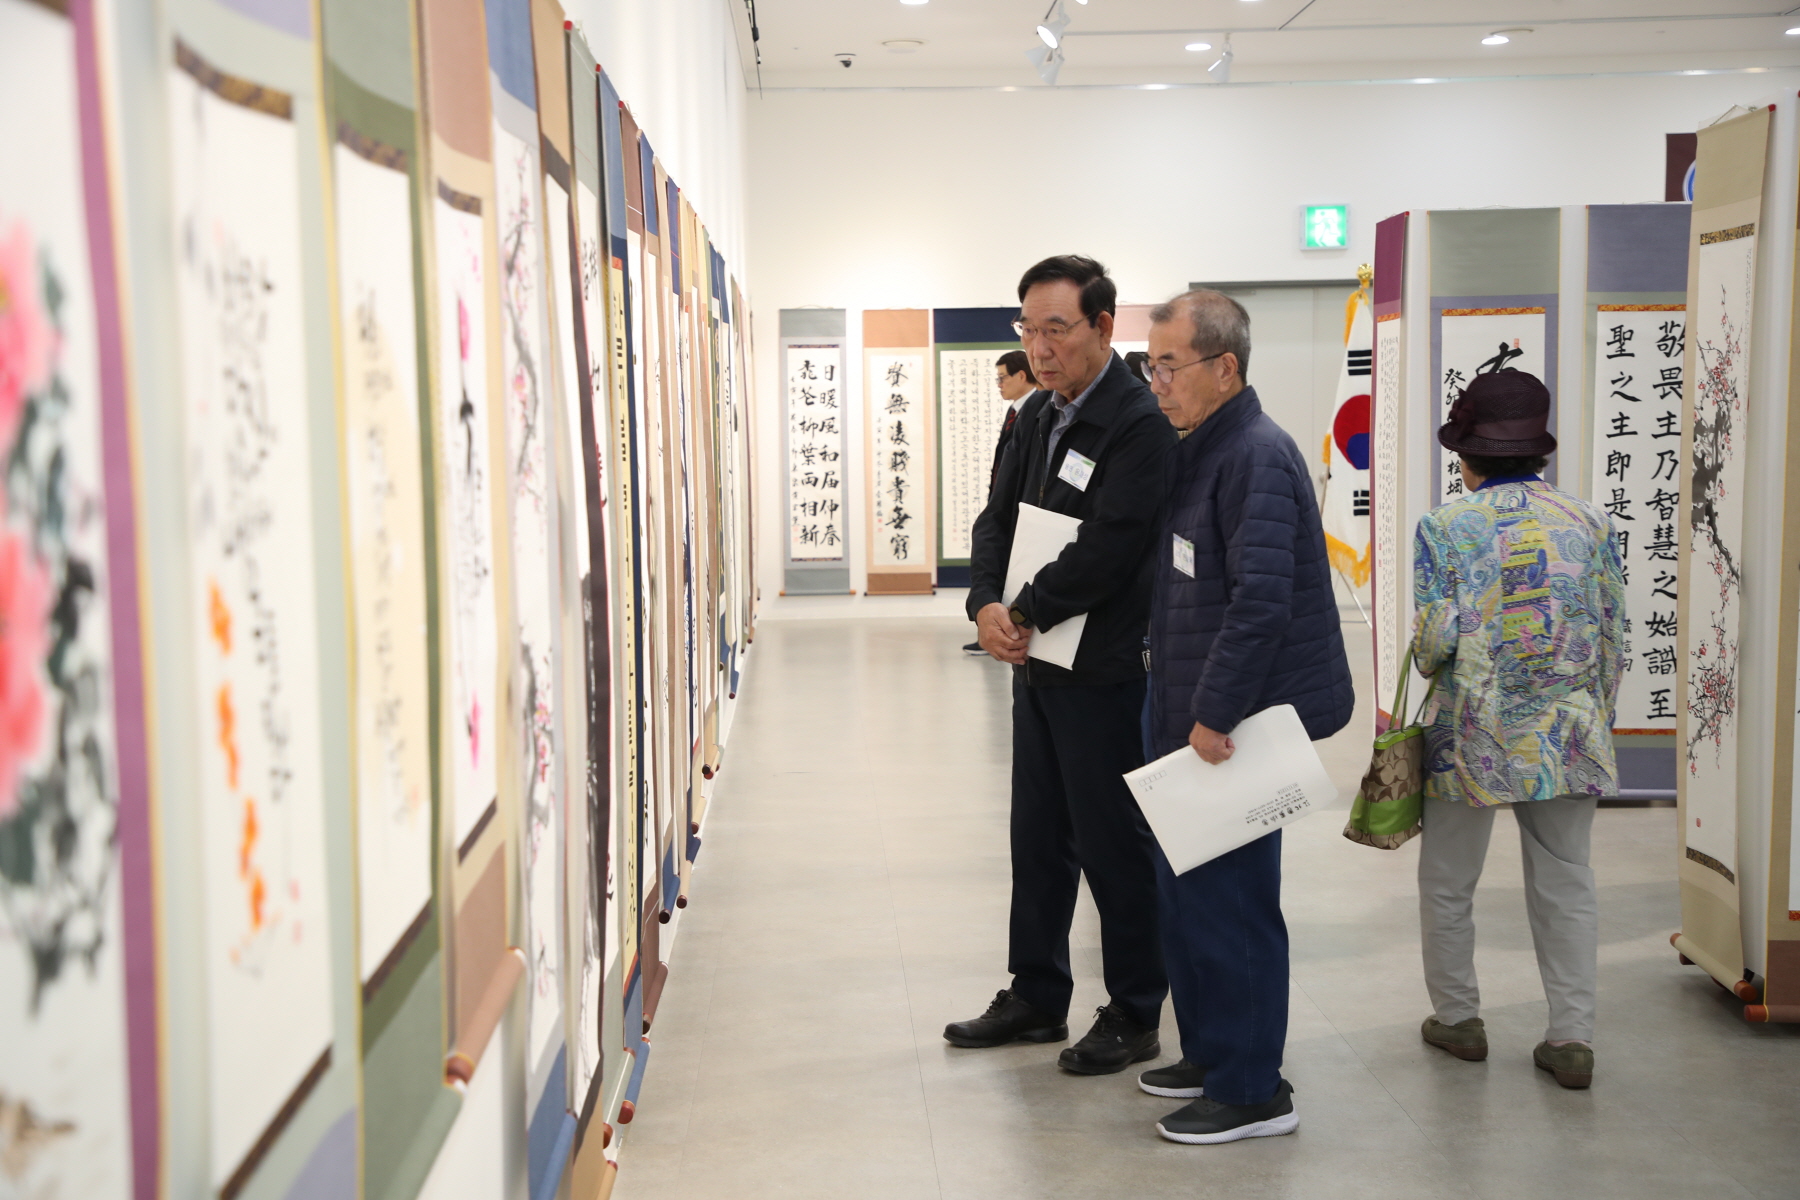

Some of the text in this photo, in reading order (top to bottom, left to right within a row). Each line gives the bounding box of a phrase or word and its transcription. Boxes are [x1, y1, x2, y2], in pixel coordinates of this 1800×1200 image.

[1604, 324, 1642, 586] 聖之主即是
